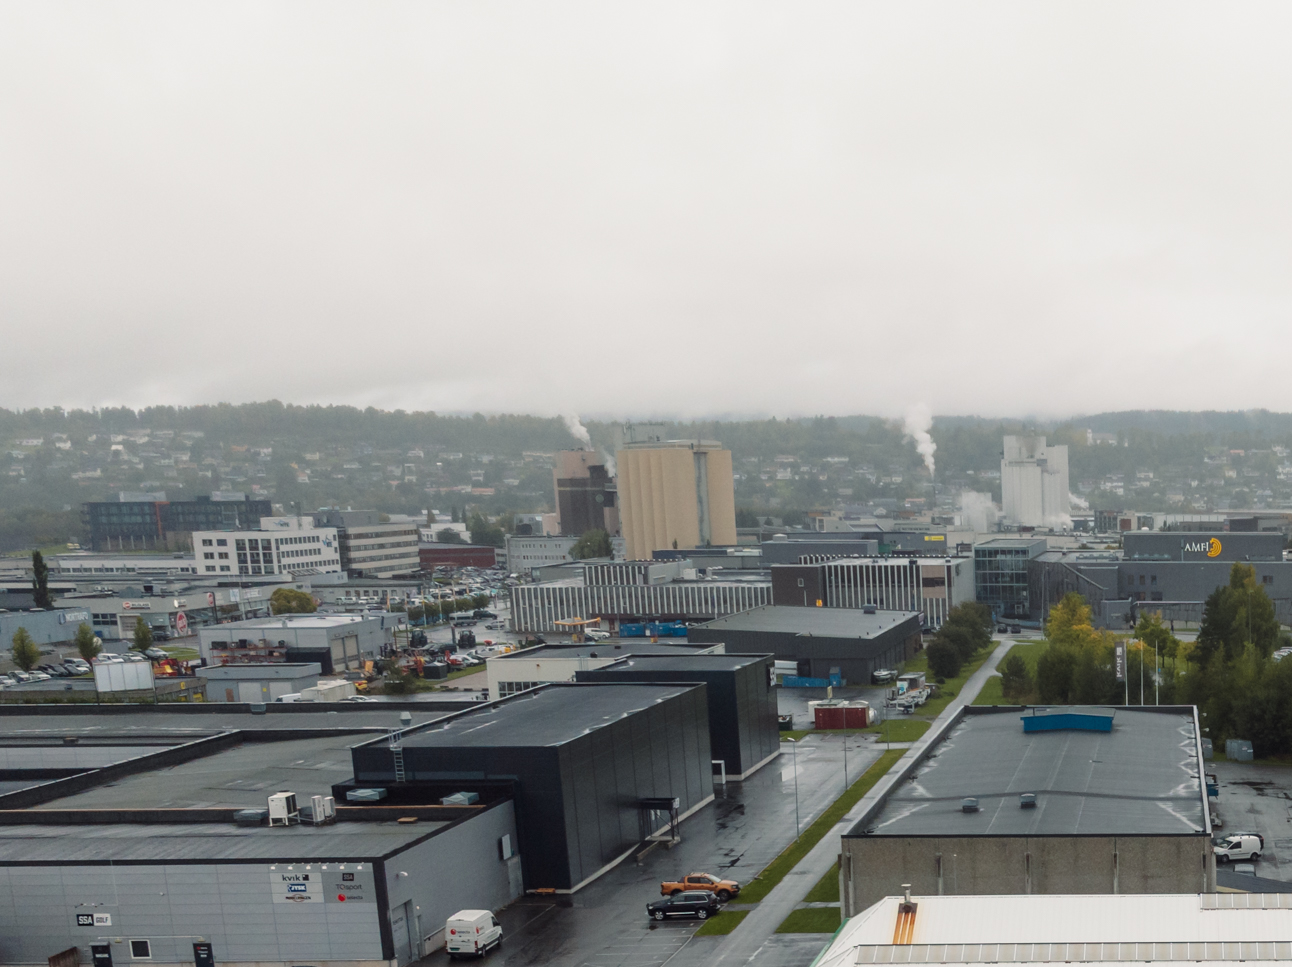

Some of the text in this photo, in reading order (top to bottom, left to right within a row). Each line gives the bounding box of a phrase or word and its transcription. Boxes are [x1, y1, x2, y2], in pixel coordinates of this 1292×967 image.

[1184, 541, 1209, 552] AMFI
[282, 874, 301, 882] kvik
[78, 915, 93, 924] SSA
